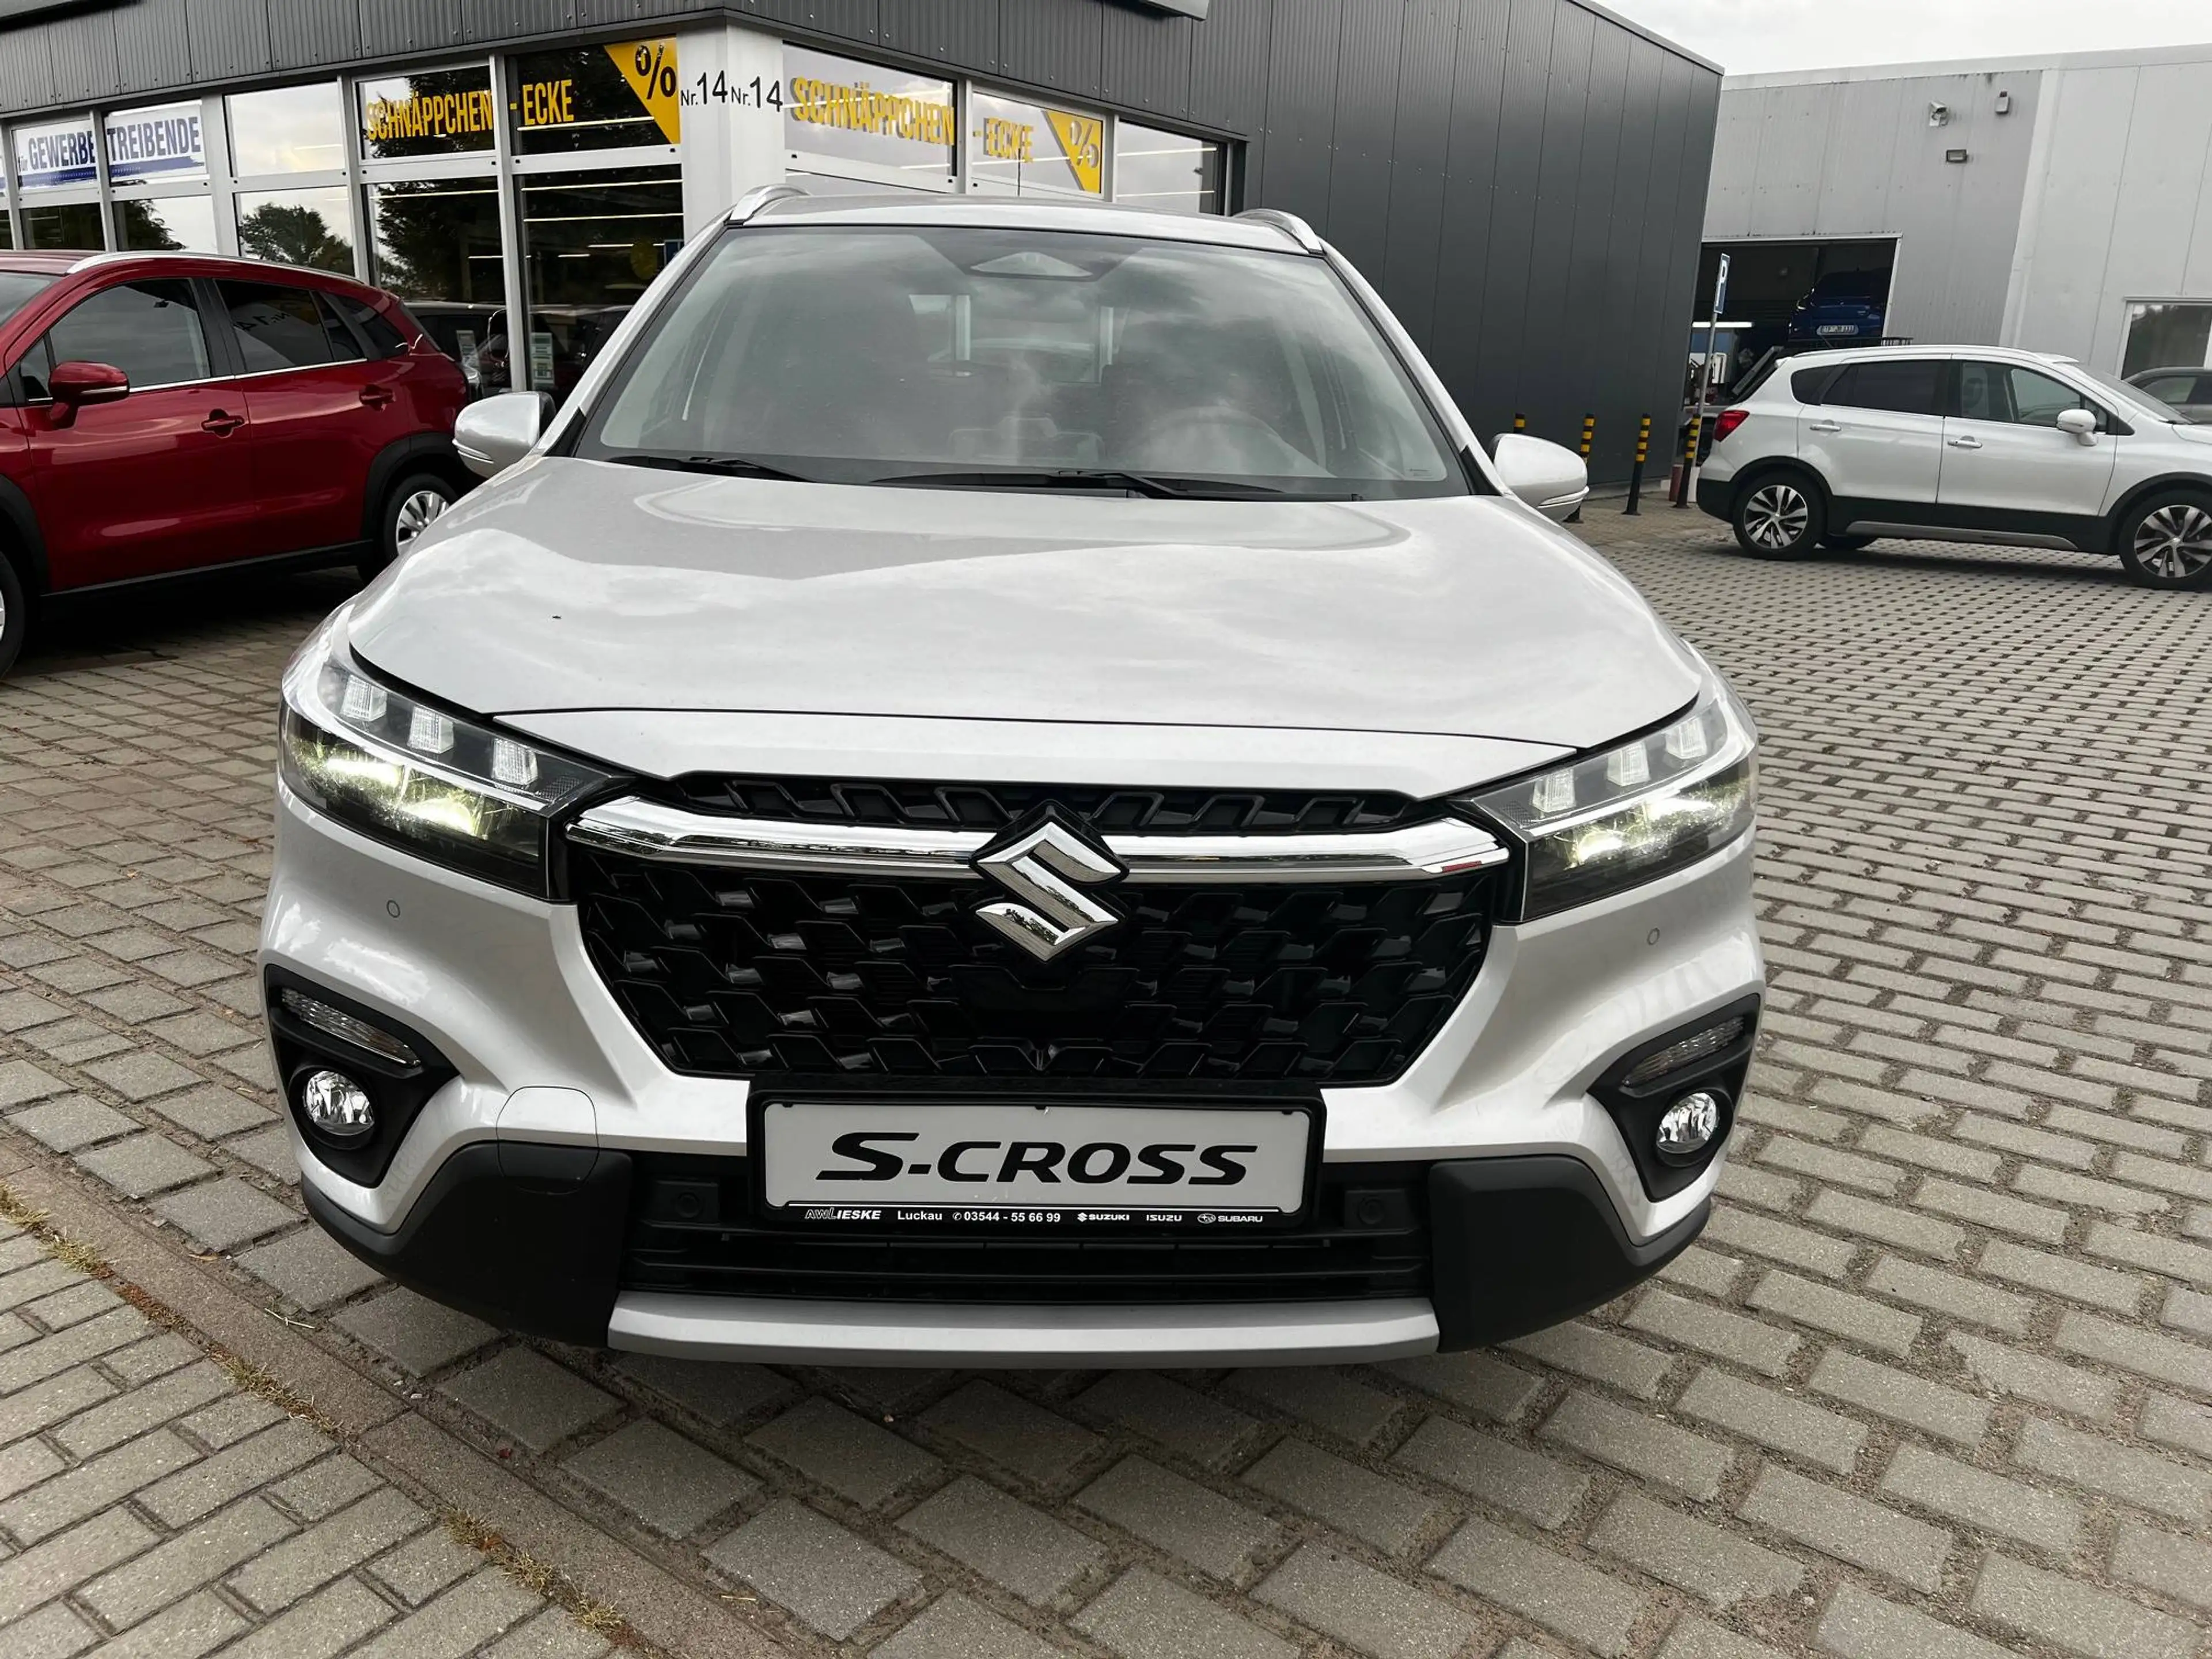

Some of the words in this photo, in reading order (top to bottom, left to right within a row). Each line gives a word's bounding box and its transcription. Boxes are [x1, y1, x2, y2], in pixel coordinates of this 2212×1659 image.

[367, 90, 493, 141] SCHNÄPPCHEN
[522, 79, 574, 126] ECKE
[793, 77, 954, 146] SCHNÄPPCHEN
[986, 118, 1033, 163] ECKE
[28, 130, 96, 171] GEWERBE
[107, 116, 200, 161] TREIBENDE
[1716, 260, 1728, 306] P
[815, 1131, 1258, 1185] S-CROSS
[897, 1210, 942, 1221] Luckau
[964, 1211, 1000, 1221] 03544
[1010, 1212, 1025, 1222] 55
[1029, 1212, 1043, 1222] 66
[1046, 1213, 1061, 1222] 99
[1088, 1213, 1130, 1221] SUZUKI
[1146, 1214, 1183, 1222] ISUZU
[1217, 1215, 1263, 1223] SUBARU
